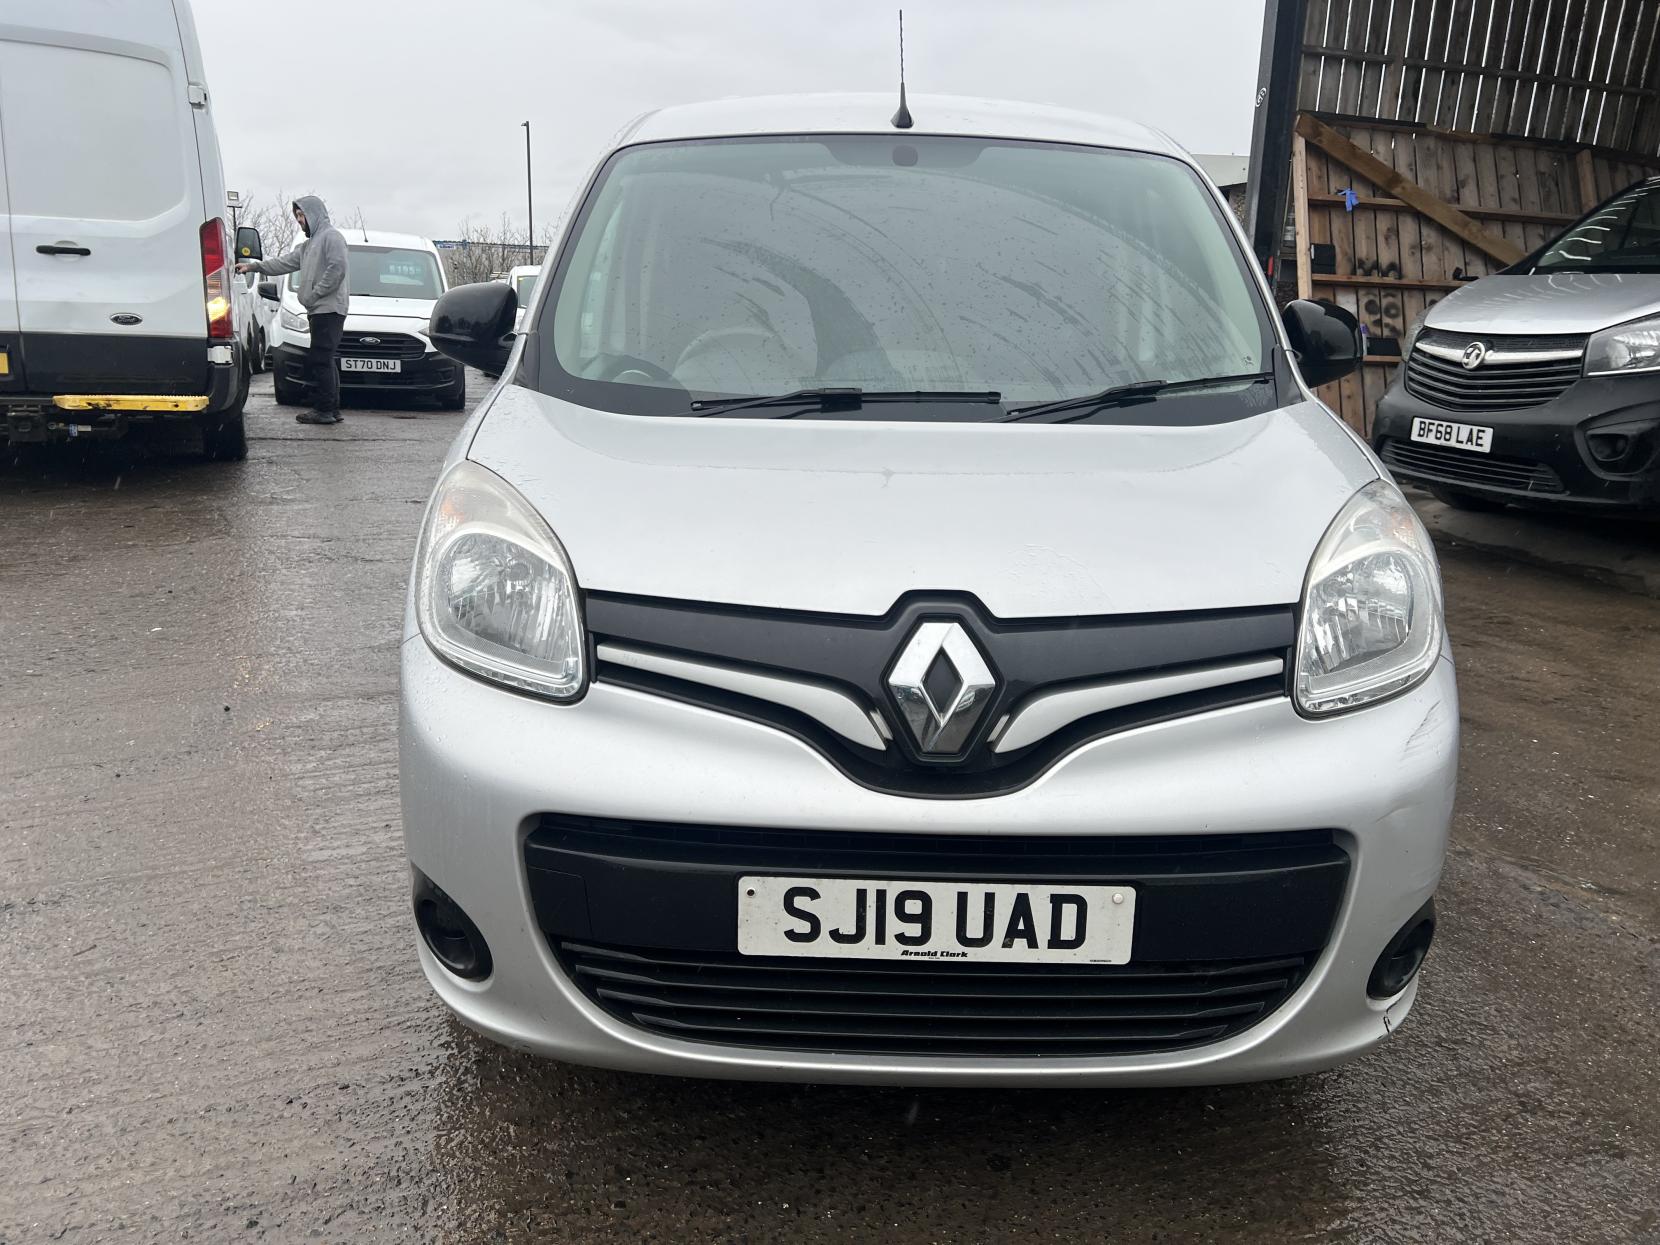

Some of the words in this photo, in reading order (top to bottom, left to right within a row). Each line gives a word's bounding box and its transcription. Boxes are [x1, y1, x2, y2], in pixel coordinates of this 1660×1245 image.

[345, 359, 373, 370] ST70
[375, 360, 396, 371] DNJ
[1417, 420, 1453, 442] BF68
[1455, 426, 1486, 447] LAE
[783, 886, 933, 946] SJ19
[956, 891, 1088, 950] UAD
[901, 949, 938, 957] Arnold
[940, 950, 968, 958] Clark
